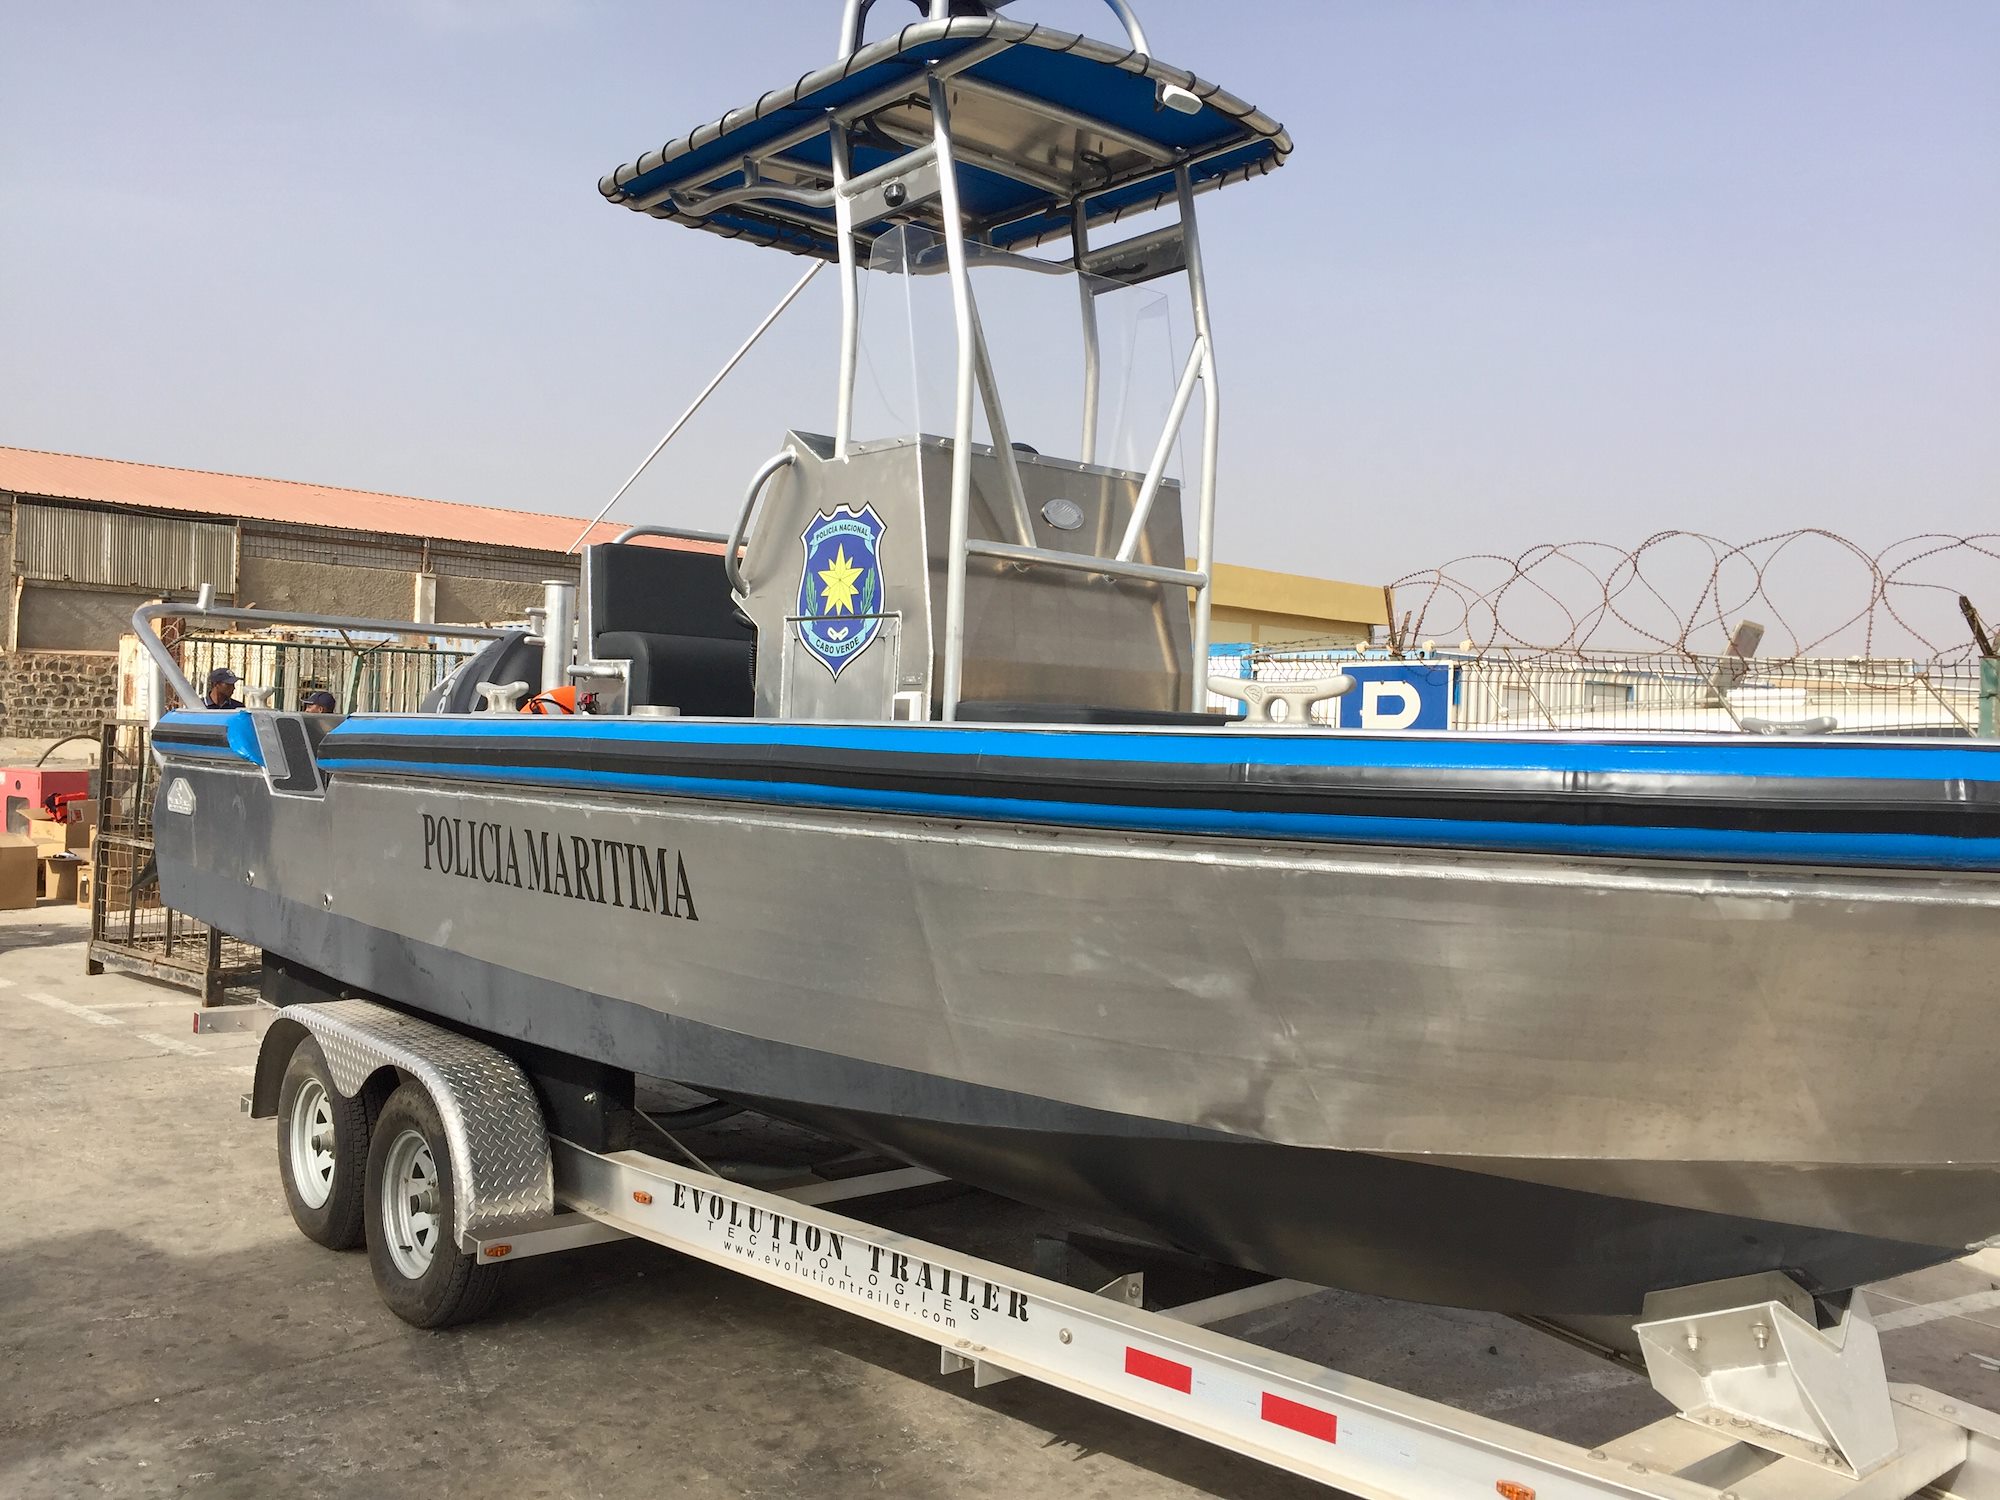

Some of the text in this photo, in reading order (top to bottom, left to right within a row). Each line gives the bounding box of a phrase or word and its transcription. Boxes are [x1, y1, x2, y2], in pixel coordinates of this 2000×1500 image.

[839, 524, 868, 537] NACIONAL
[816, 636, 860, 654] CABO VERDE
[422, 813, 699, 921] POLICIA MARITIMA
[673, 1183, 1030, 1323] EVOLUTION TRAILER
[707, 1220, 980, 1321] TECHNOLOGIES
[723, 1241, 957, 1329] www.evolutiontrailer.com
